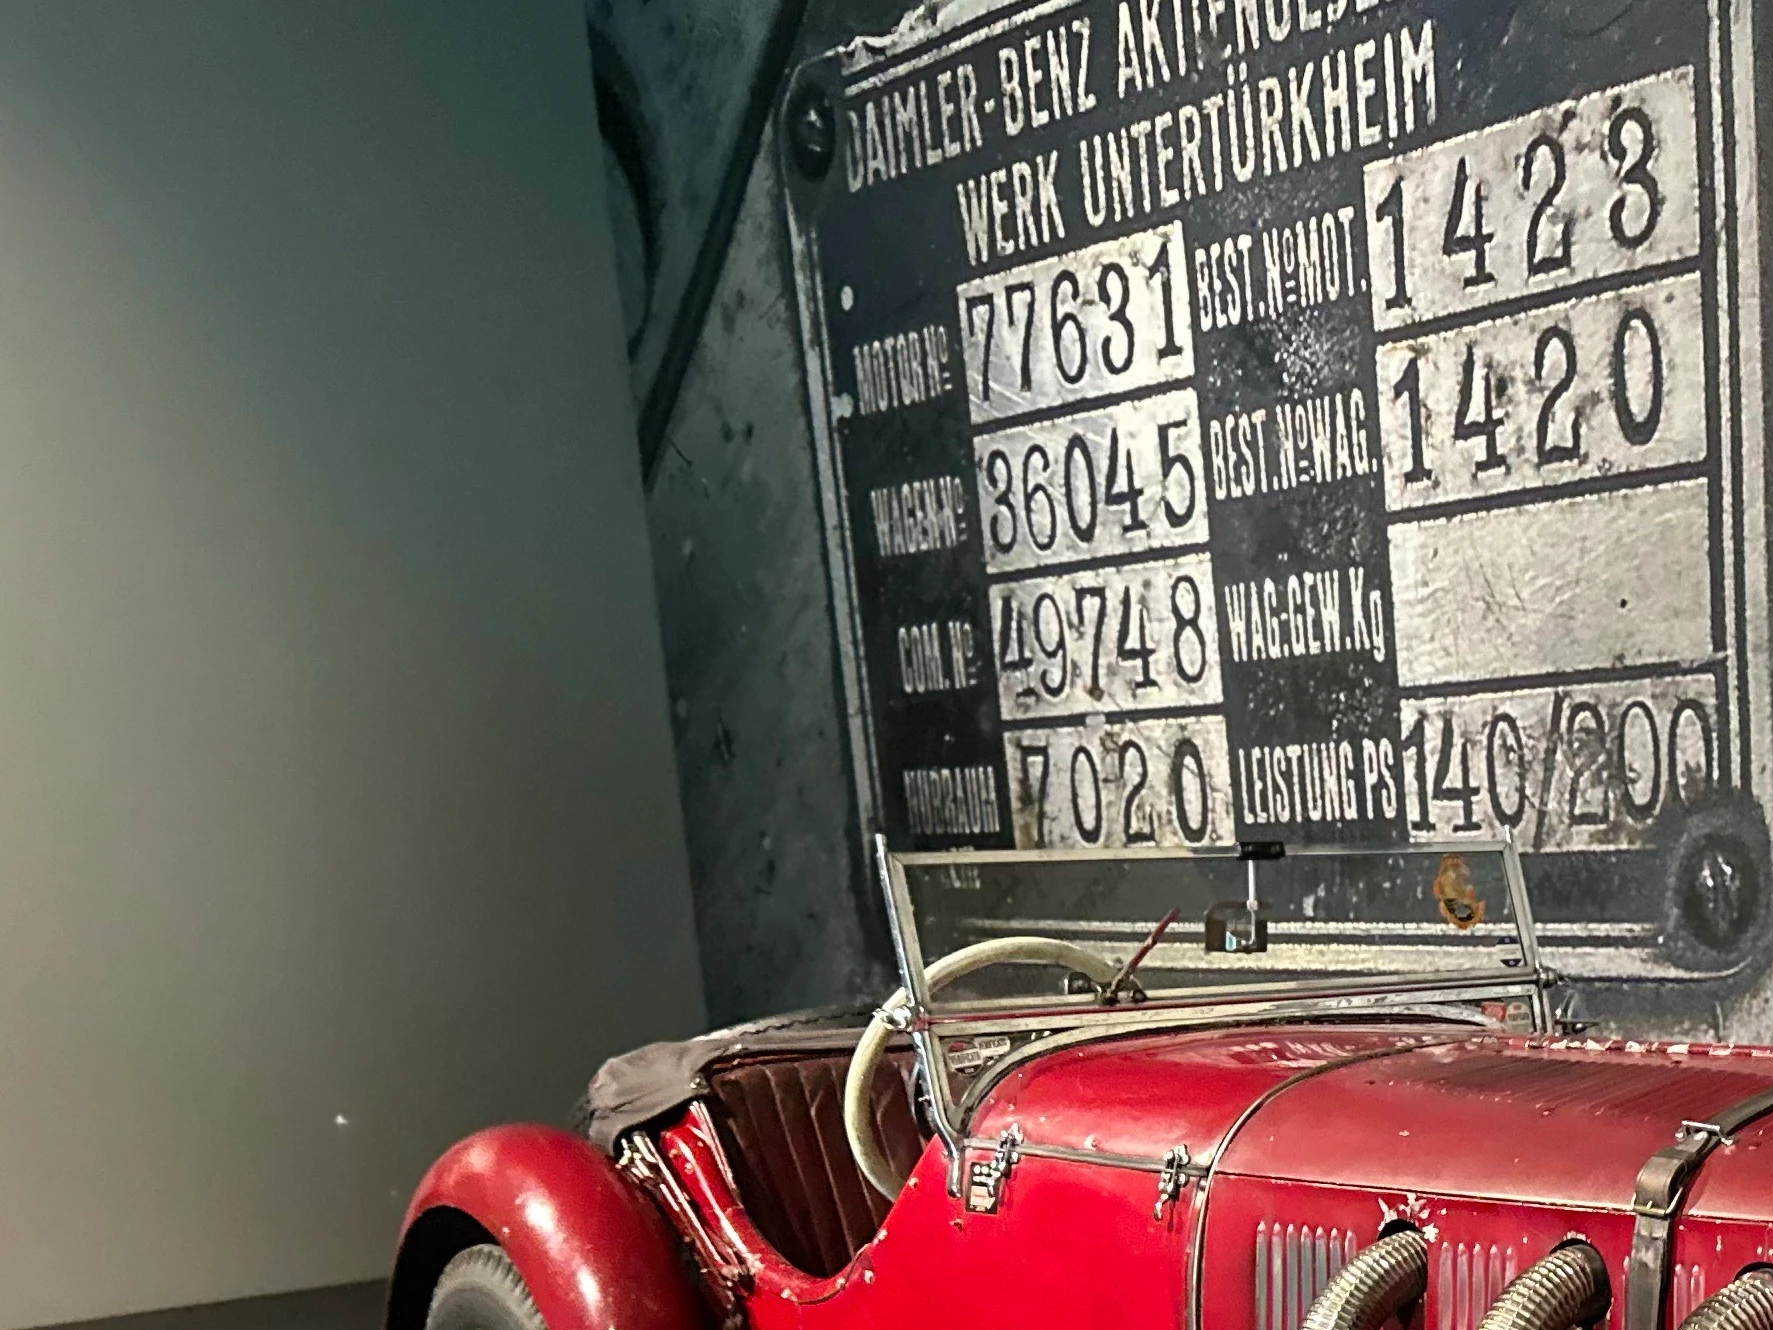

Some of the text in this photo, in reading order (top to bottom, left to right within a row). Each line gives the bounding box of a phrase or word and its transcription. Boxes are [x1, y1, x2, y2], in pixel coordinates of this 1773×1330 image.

[845, 17, 1097, 193] DAIMLER-BENZ
[957, 19, 1438, 266] WERK UNTERTÜRKHEIM
[1374, 106, 1661, 309] 1423
[964, 241, 1184, 403] 77631
[1392, 306, 1664, 484] 1420
[984, 419, 1197, 554] 36045
[1000, 574, 1207, 702] 49748
[1018, 738, 1209, 848] 7020
[1238, 737, 1398, 824] LEISTUNG PS
[1402, 690, 1715, 851] 140/200
